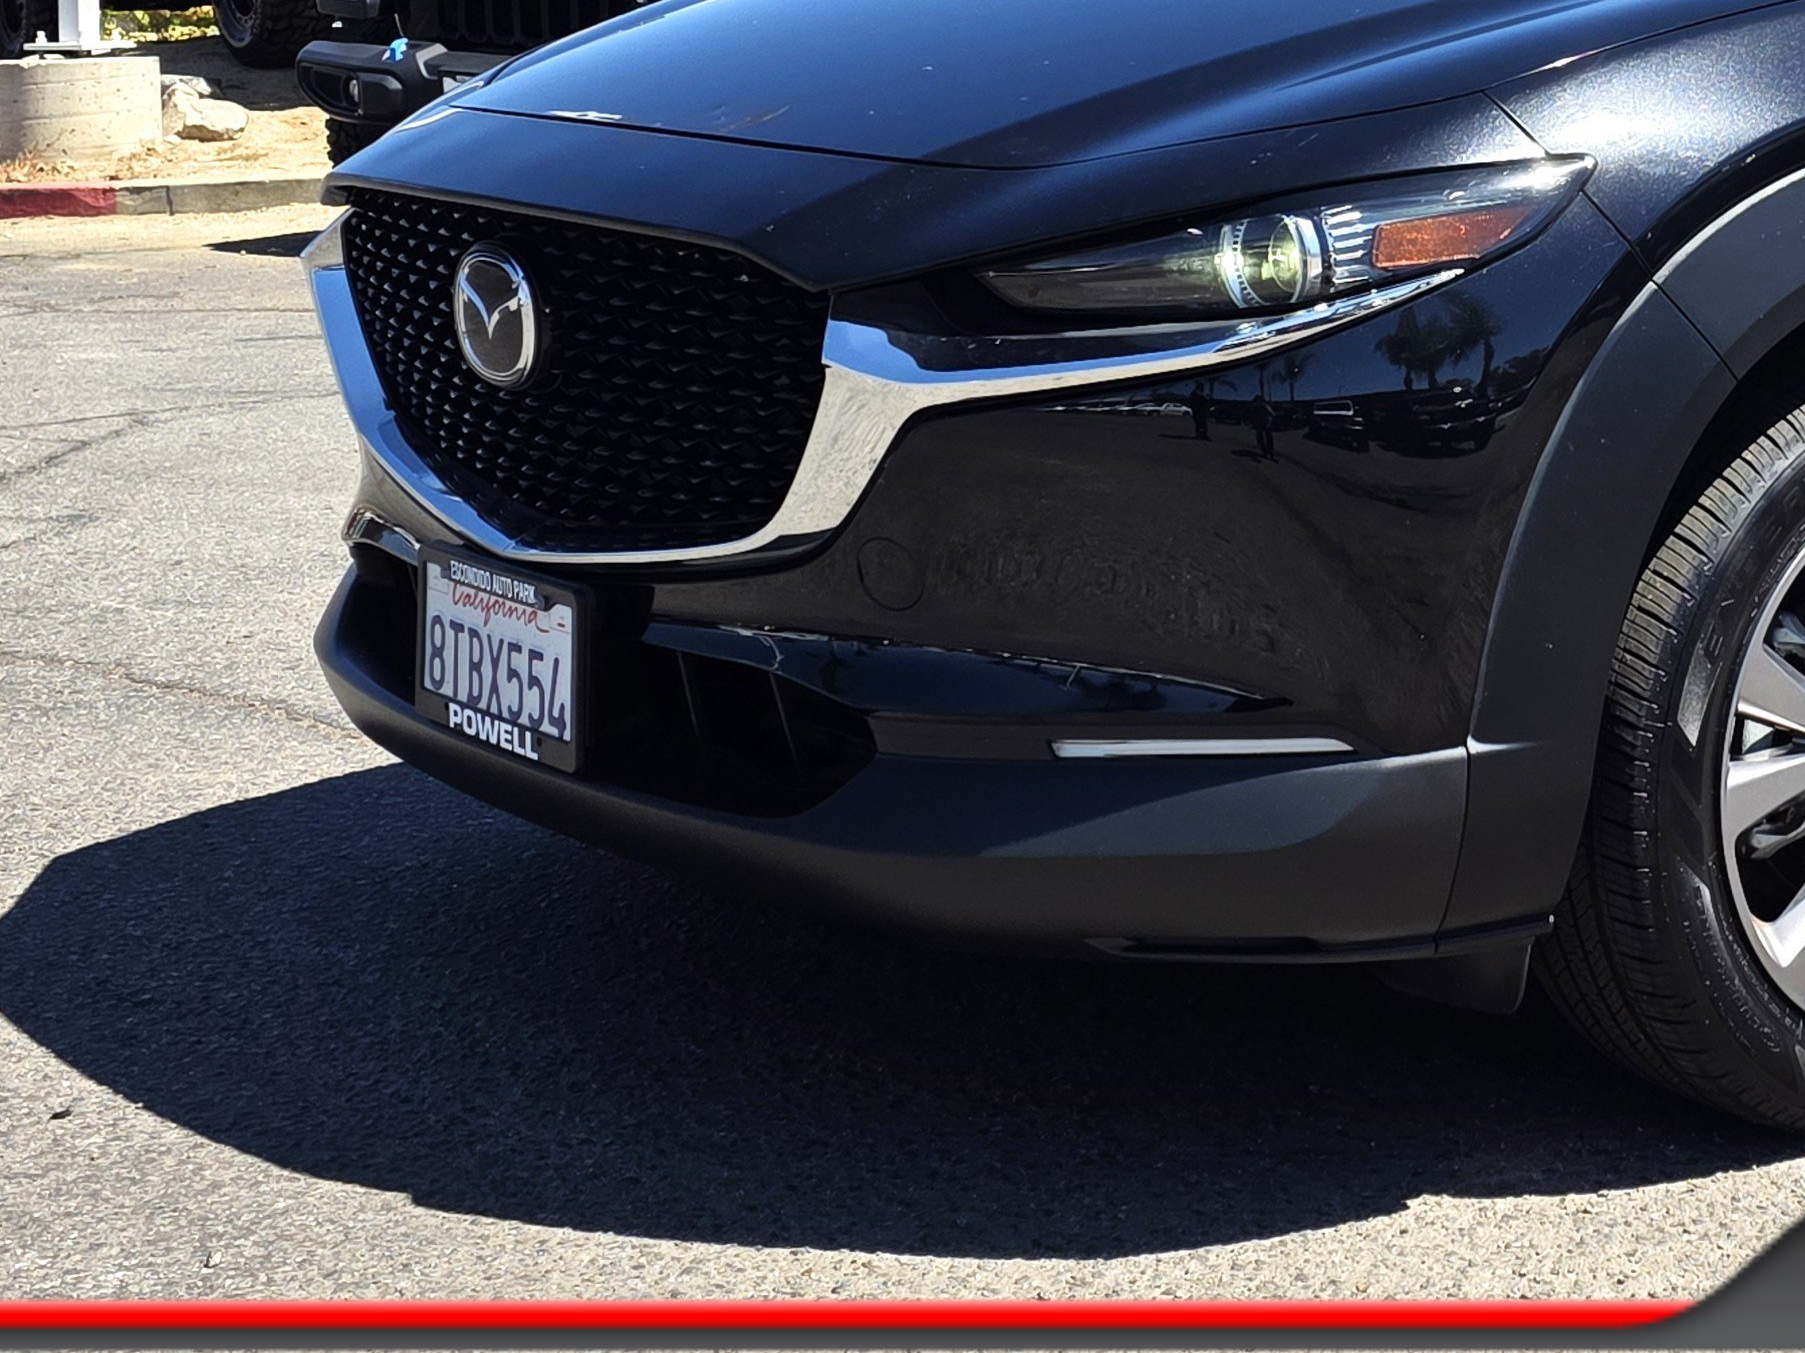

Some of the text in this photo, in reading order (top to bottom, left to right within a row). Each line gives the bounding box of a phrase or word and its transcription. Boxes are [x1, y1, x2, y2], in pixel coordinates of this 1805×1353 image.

[452, 583, 550, 633] California
[492, 574, 513, 599] AUTO
[513, 580, 537, 604] PARK
[429, 614, 567, 739] 8TBX554
[448, 703, 539, 761] POWELL
